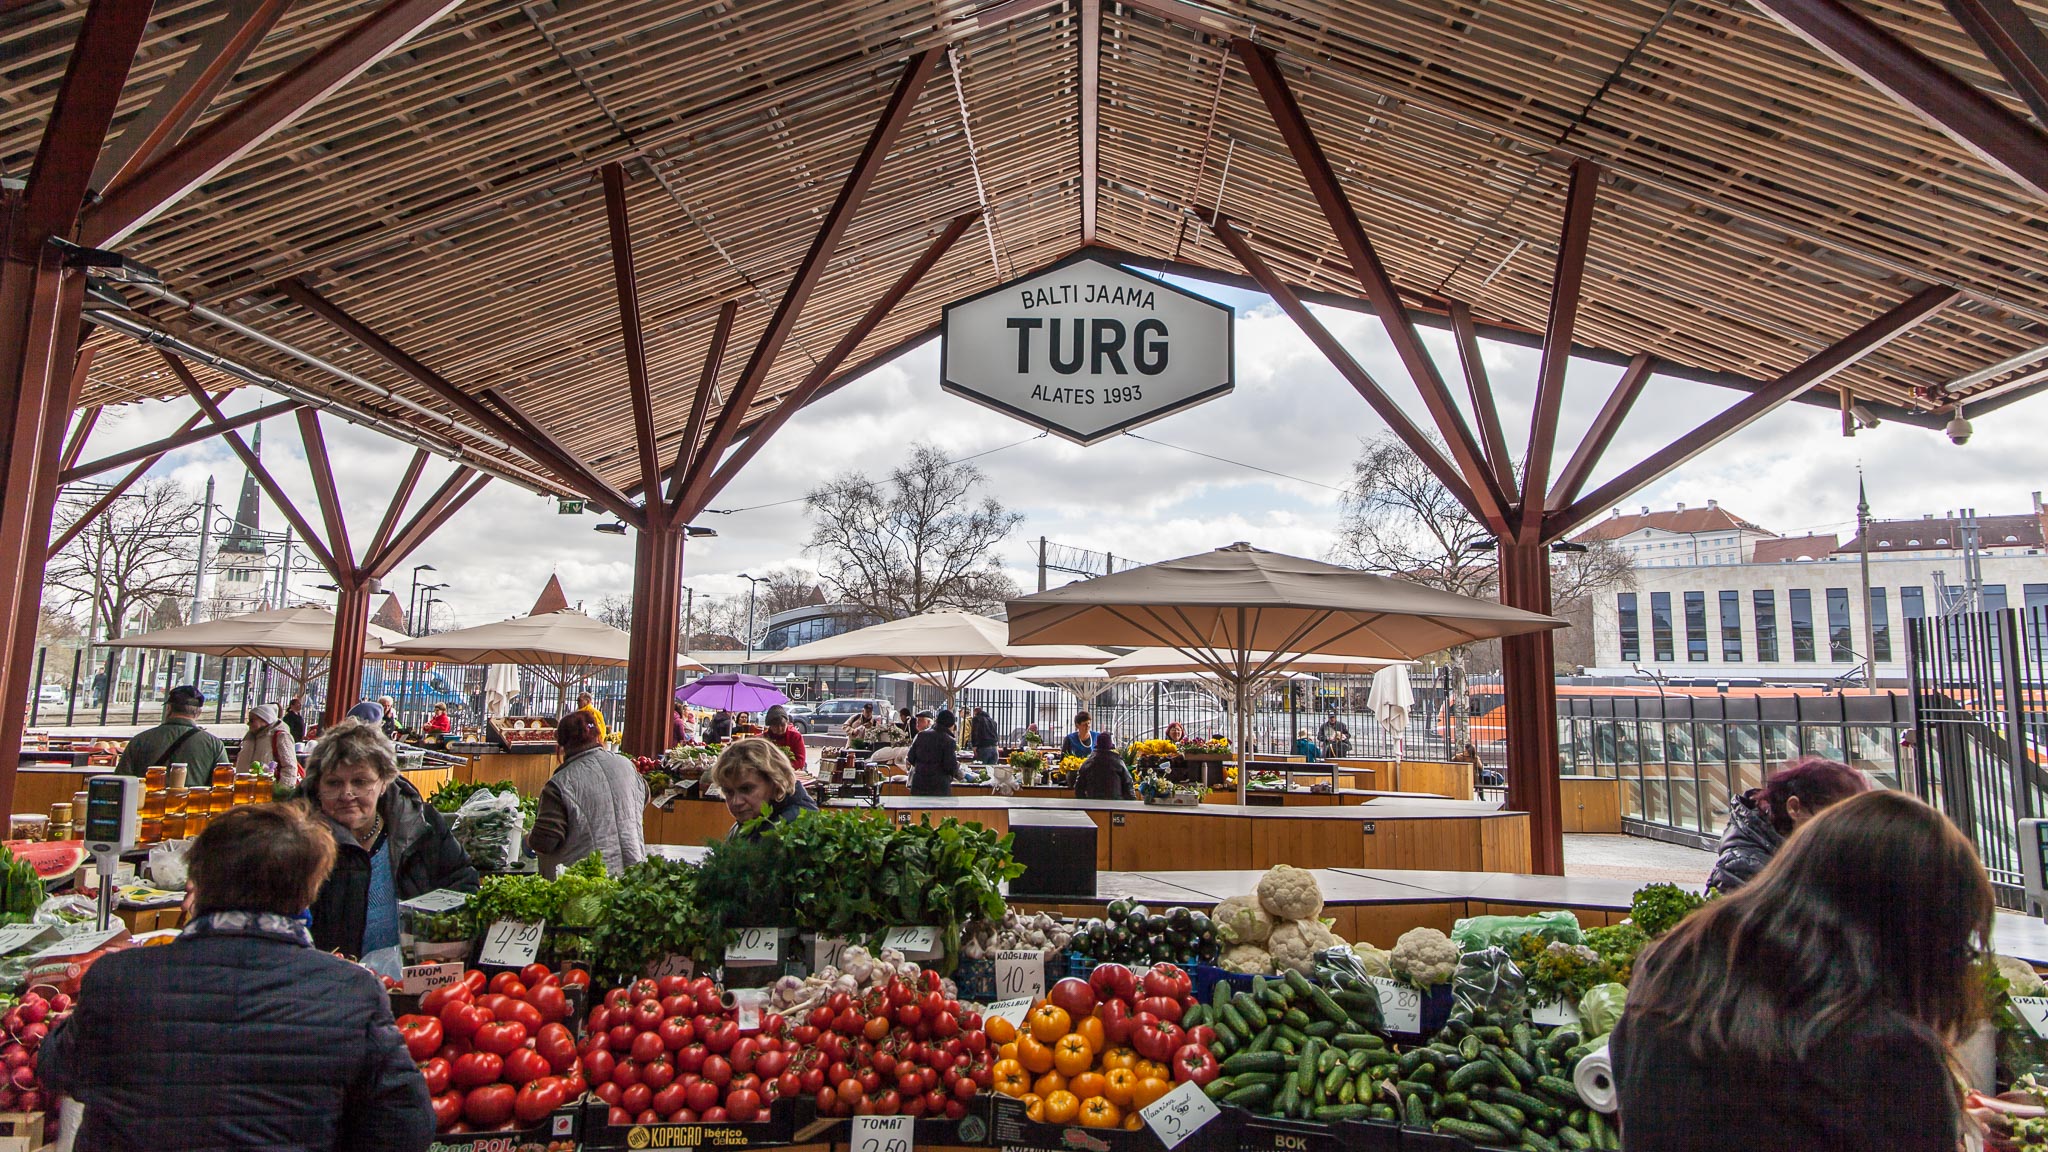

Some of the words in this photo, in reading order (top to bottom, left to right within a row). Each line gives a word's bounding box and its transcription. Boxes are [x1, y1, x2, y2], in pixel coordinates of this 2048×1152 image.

[1022, 285, 1078, 310] BALTI
[1084, 285, 1155, 310] JAAMA
[1007, 317, 1169, 375] TURG
[1031, 384, 1095, 404] ALATES
[1103, 384, 1142, 404] 1993
[407, 966, 442, 978] PLOOM
[1398, 991, 1418, 1008] 80
[861, 1117, 907, 1130] TOMAT
[1164, 1114, 1181, 1135] 3
[1176, 1105, 1190, 1114] 90
[651, 1126, 702, 1147] KOPAGRO
[1275, 1134, 1307, 1150] BOK
